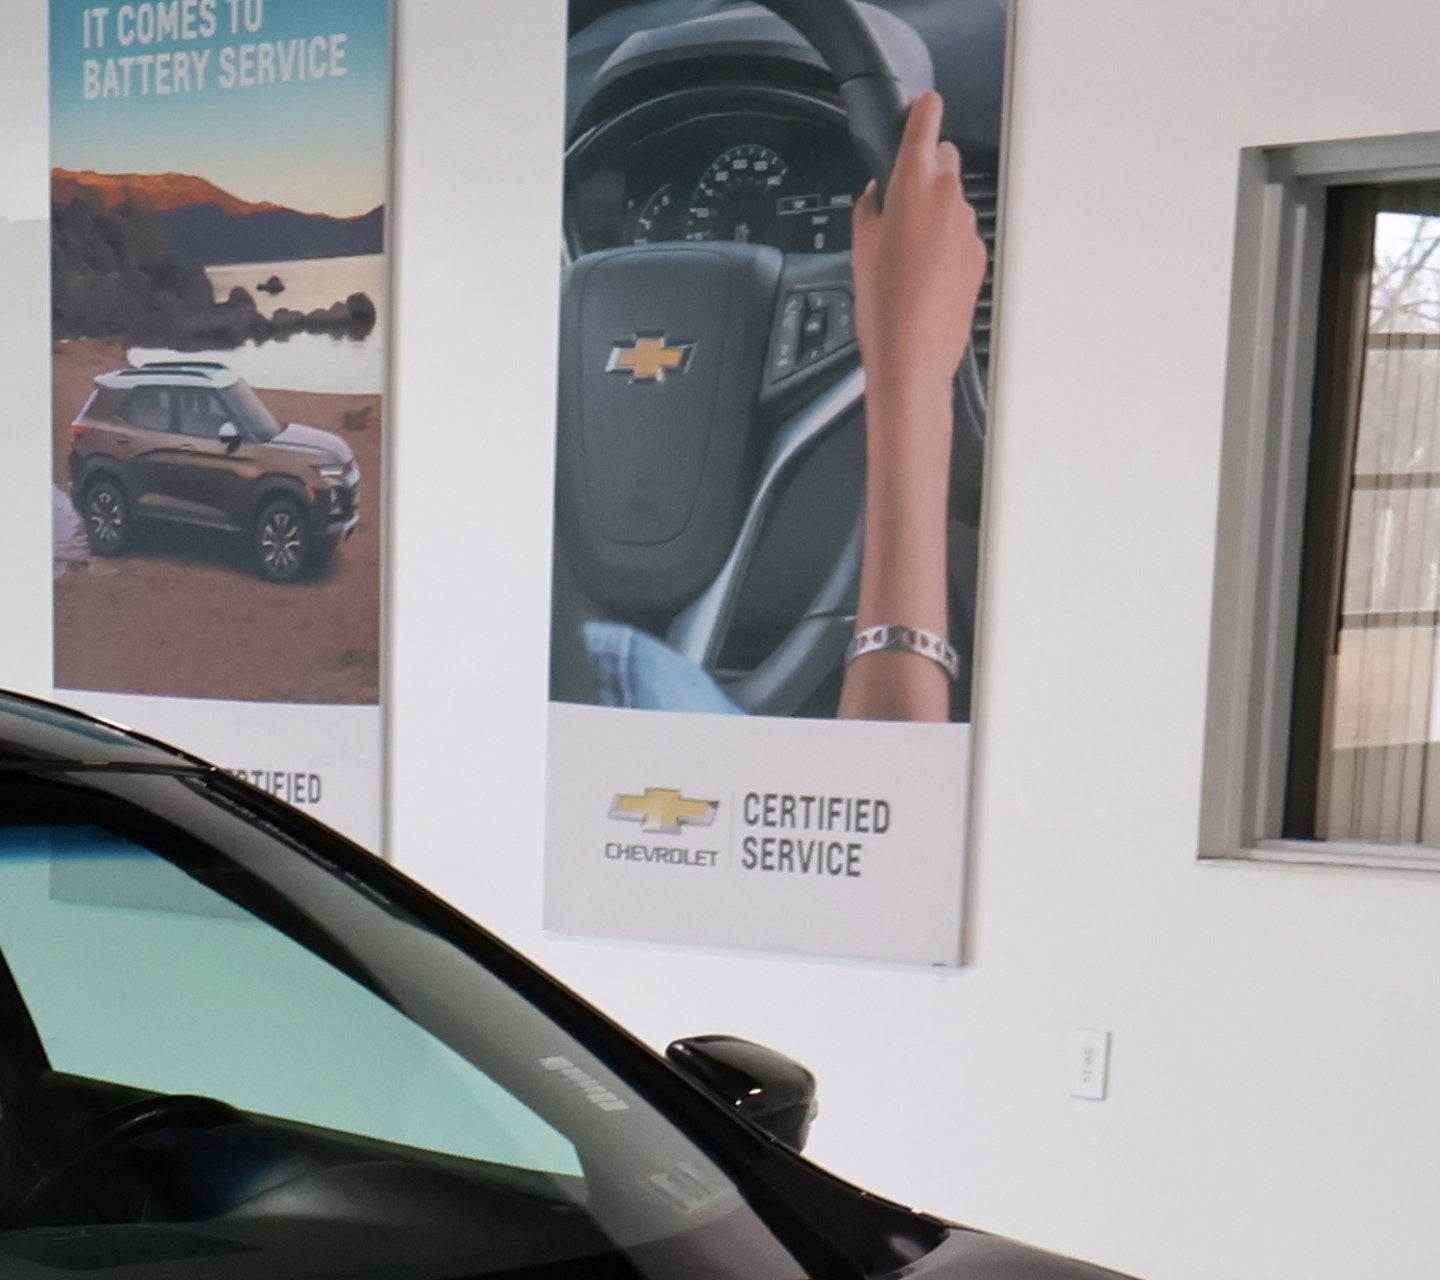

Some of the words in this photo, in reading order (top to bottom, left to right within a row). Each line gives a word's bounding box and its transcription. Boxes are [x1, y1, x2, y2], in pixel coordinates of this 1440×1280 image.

[83, 7, 109, 48] IT
[117, 0, 217, 46] COMES
[227, 0, 264, 34] TO
[83, 50, 210, 100] BATTERY
[219, 33, 348, 89] SERVICE
[231, 769, 322, 804] TIFIED
[743, 792, 890, 834] CERTIFIED
[604, 842, 719, 867] CHEVROLET
[741, 836, 862, 877] SERVICE
